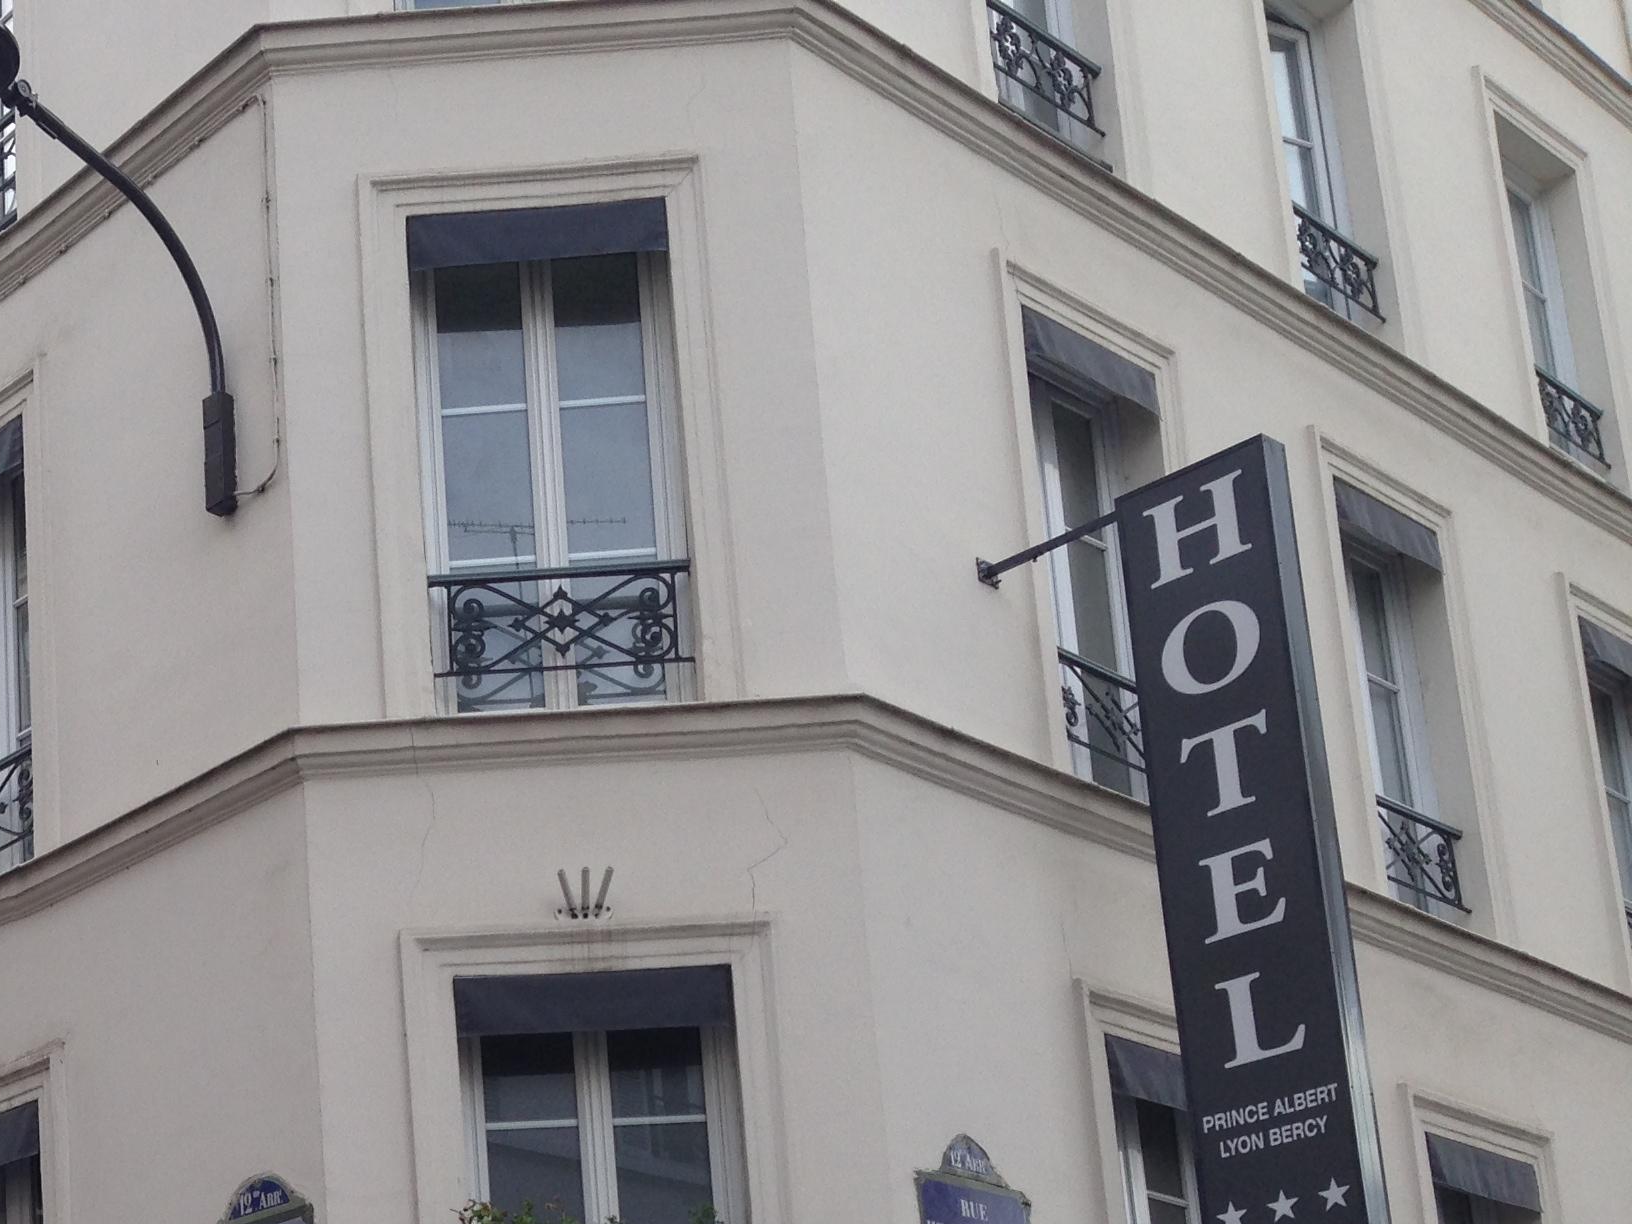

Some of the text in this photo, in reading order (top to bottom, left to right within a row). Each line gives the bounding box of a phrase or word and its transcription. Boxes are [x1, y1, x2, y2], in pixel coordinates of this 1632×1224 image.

[1142, 468, 1306, 1069] HOTEL
[1202, 1083, 1338, 1134] PRINCE ALBERT
[1220, 1115, 1328, 1159] LYON BERCY
[960, 1199, 988, 1221] RUE
